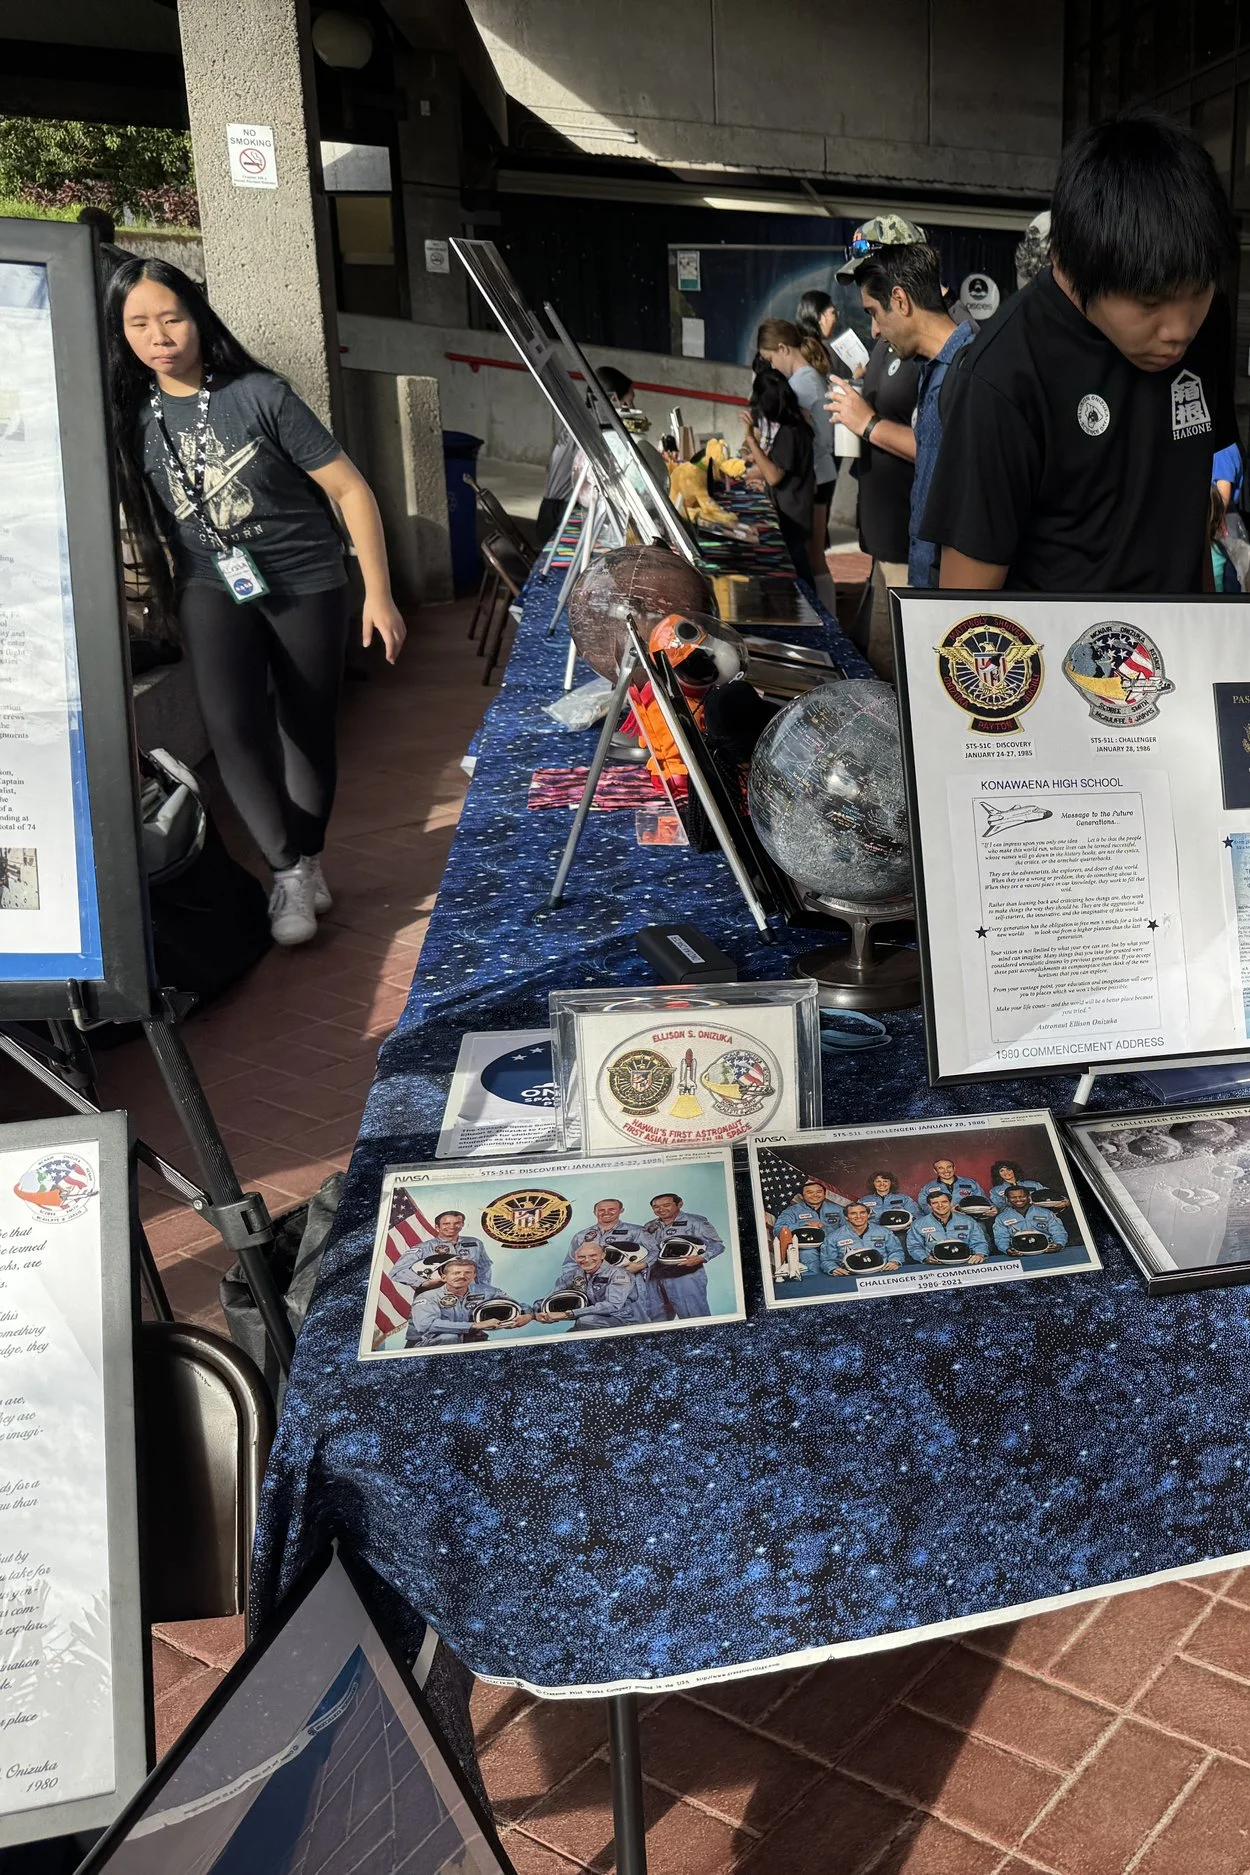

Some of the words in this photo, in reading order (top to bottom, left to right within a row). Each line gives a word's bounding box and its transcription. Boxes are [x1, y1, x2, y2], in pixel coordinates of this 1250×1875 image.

[230, 137, 272, 147] SMOKING
[1173, 422, 1212, 440] HAKONE
[1121, 627, 1145, 643] ONIZUKA
[944, 676, 969, 708] ONIZUKA
[1131, 700, 1149, 712] SMITH
[1135, 708, 1154, 722] JARVIS
[978, 721, 1012, 730] PAYTON
[996, 741, 1031, 749] DISCOVERY
[965, 751, 995, 759] JANUARY
[981, 780, 1050, 790] KONAWAENA
[1052, 779, 1078, 788] HIGH
[1080, 778, 1123, 787] SCHOOL
[1037, 1021, 1068, 1031] Astronaut
[1092, 1018, 1118, 1026] Onizuka
[652, 1031, 685, 1044] ELLISON
[688, 1030, 696, 1038] S.
[699, 1031, 733, 1044] ONIZUKA
[996, 1048, 1020, 1060] 1980
[1022, 1041, 1113, 1058] COMMENCEMENT
[1116, 1037, 1165, 1050] ADDRESS
[1111, 1118, 1168, 1128] CHALLENGER
[1170, 1113, 1206, 1121] CRATERS
[623, 1123, 643, 1138] FIRST
[644, 1133, 669, 1144] ASIAN
[727, 1124, 752, 1139] SPACE
[631, 1119, 667, 1136] HAWAII'S
[695, 1119, 744, 1138] ASTRONAUT
[395, 1175, 430, 1183] NASA
[9, 1227, 32, 1238] that
[9, 1240, 47, 1254] termed
[859, 1276, 916, 1287] CHALLENGER
[937, 1264, 1020, 1278] COMMEMORATION
[918, 1279, 963, 1289] 1986-2021
[27, 1341, 49, 1353] they
[13, 1497, 38, 1509] than
[4, 1712, 38, 1730] place
[6, 1760, 58, 1778] Onizuka
[26, 1777, 58, 1792] 1980
